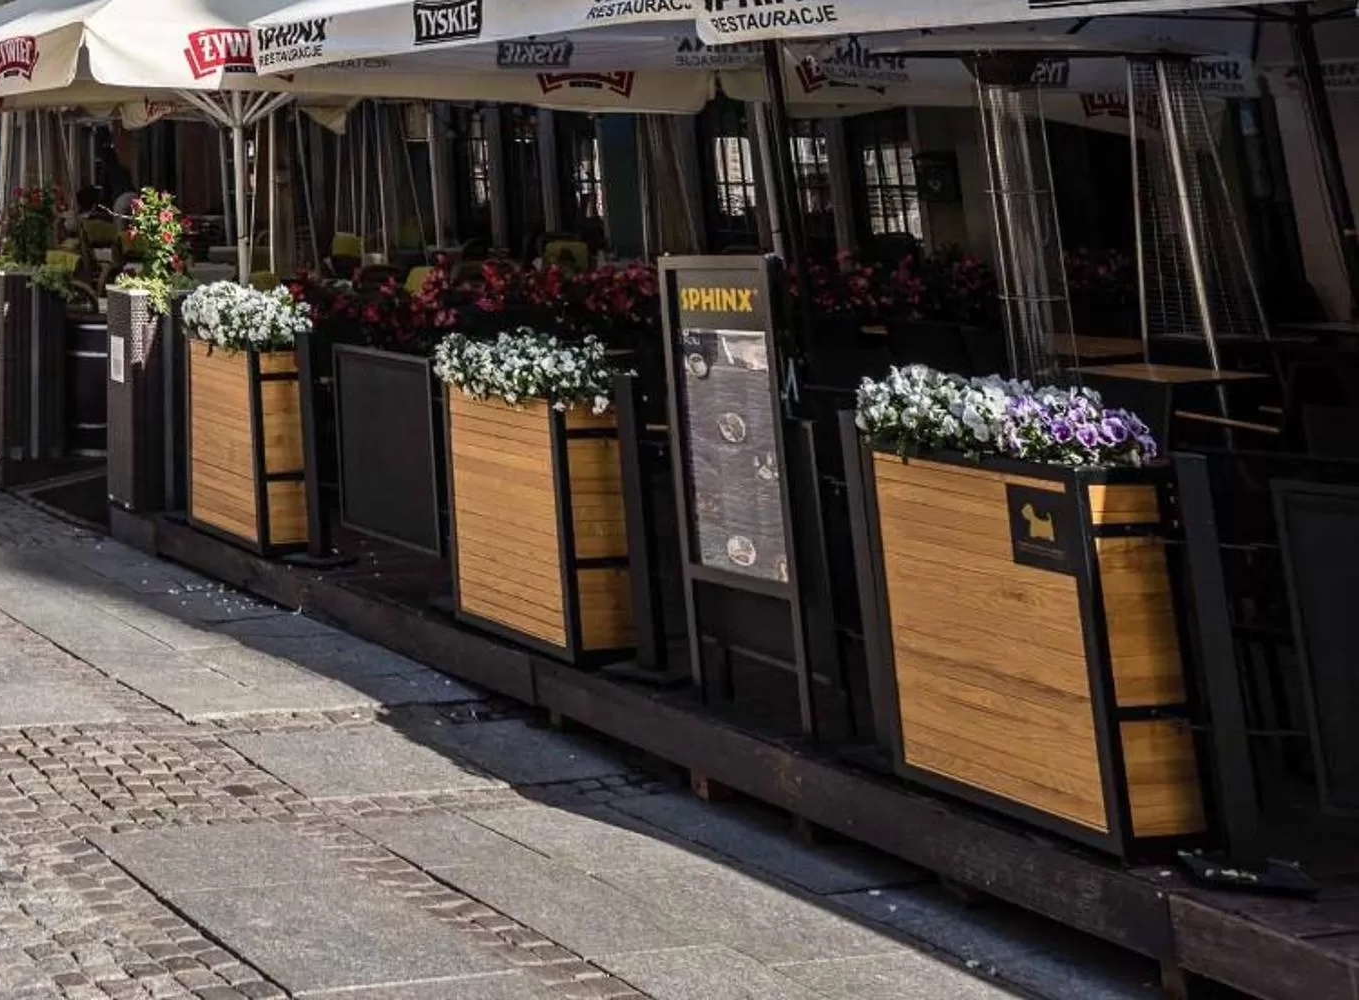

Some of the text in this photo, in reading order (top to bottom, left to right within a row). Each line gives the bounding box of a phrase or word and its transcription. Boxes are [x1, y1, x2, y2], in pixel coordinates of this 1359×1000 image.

[257, 18, 327, 51] SPHINX
[416, 0, 478, 37] TYSKIE
[710, 4, 838, 34] RESTAURACJE
[198, 30, 250, 62] ŻYW
[681, 287, 752, 312] SPHINX
